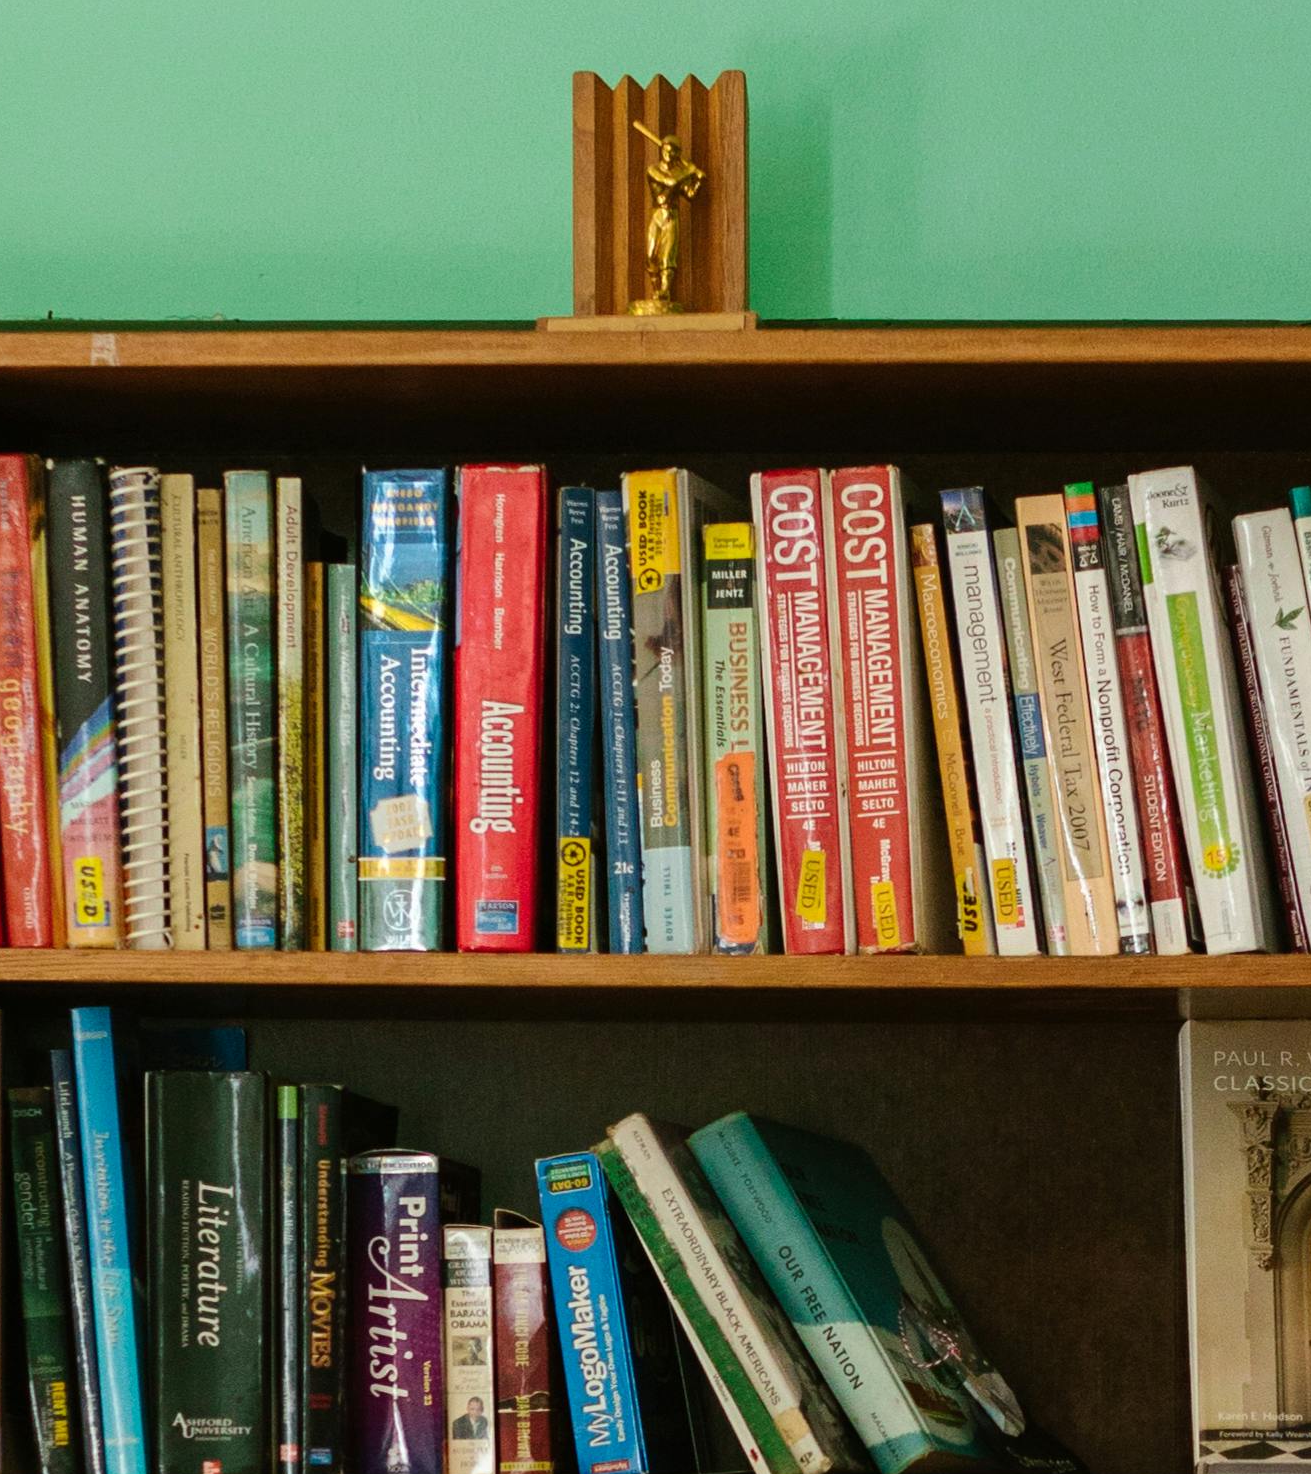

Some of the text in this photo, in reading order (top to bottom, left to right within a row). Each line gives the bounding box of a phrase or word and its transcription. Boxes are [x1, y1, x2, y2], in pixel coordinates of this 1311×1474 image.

[70, 494, 93, 685] HUMAN ANATOMY
[285, 503, 301, 650] Adult Development
[563, 536, 588, 636] Accounting
[602, 542, 624, 642] Accounting
[711, 568, 748, 582] MILLER
[714, 587, 745, 599] JENTZ
[769, 483, 828, 750] COST MANAGEMENT
[840, 481, 897, 749] COST MANAGEMENT
[725, 620, 751, 736] BUSINESS
[920, 571, 950, 721] Macroeconomics
[963, 563, 999, 704] management
[371, 653, 400, 781] Accounting
[408, 646, 427, 787] Intermediate
[468, 698, 526, 836] Accounting
[658, 644, 678, 828] Communication Today
[785, 759, 828, 774] HILTON
[1046, 637, 1092, 854] West Federal Tax 2007
[1189, 706, 1225, 825] Marketing
[649, 758, 663, 829] Business
[786, 778, 827, 794] MAHER
[789, 797, 826, 813] SELTO
[1095, 678, 1133, 877] Nonprofit Corporation
[1141, 773, 1168, 884] STUDENT EDITION
[613, 860, 635, 876] 21e
[797, 856, 823, 913] USED
[874, 886, 898, 944] USED
[995, 861, 1016, 919] USED
[1213, 1050, 1273, 1068] PAUL
[1280, 1051, 1301, 1068] R.
[194, 1179, 236, 1350] Literature
[398, 1194, 426, 1277] Print
[307, 1272, 333, 1371] MOVIES
[366, 1234, 429, 1399] Artist
[448, 1309, 489, 1319] BARACK
[449, 1319, 488, 1330] OBAMA
[660, 1186, 784, 1407] EXTRAORDINARY BLACK AMERICANS
[775, 1244, 865, 1392] OUR FREE NATION
[565, 1264, 614, 1450] MyLogoMaker
